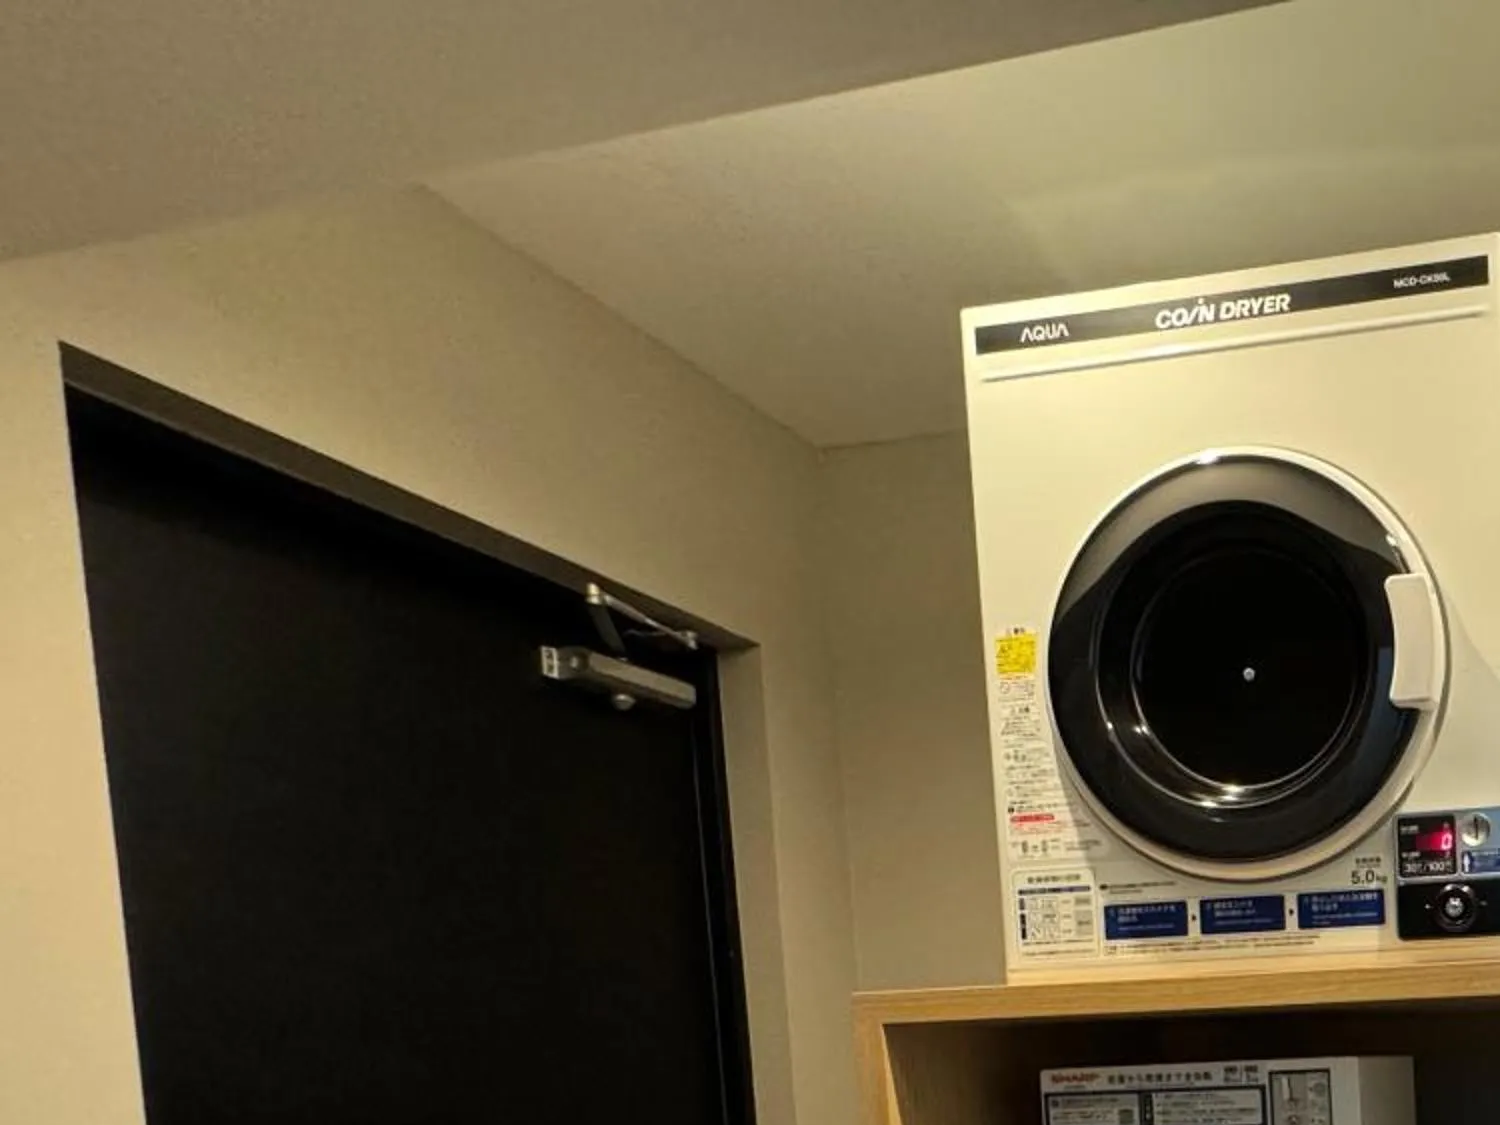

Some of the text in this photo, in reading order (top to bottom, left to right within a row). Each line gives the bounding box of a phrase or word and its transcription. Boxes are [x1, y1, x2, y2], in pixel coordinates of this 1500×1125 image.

[1155, 293, 1292, 330] COIN DRYER
[1020, 322, 1070, 343] AQUA
[1441, 832, 1453, 850] 0
